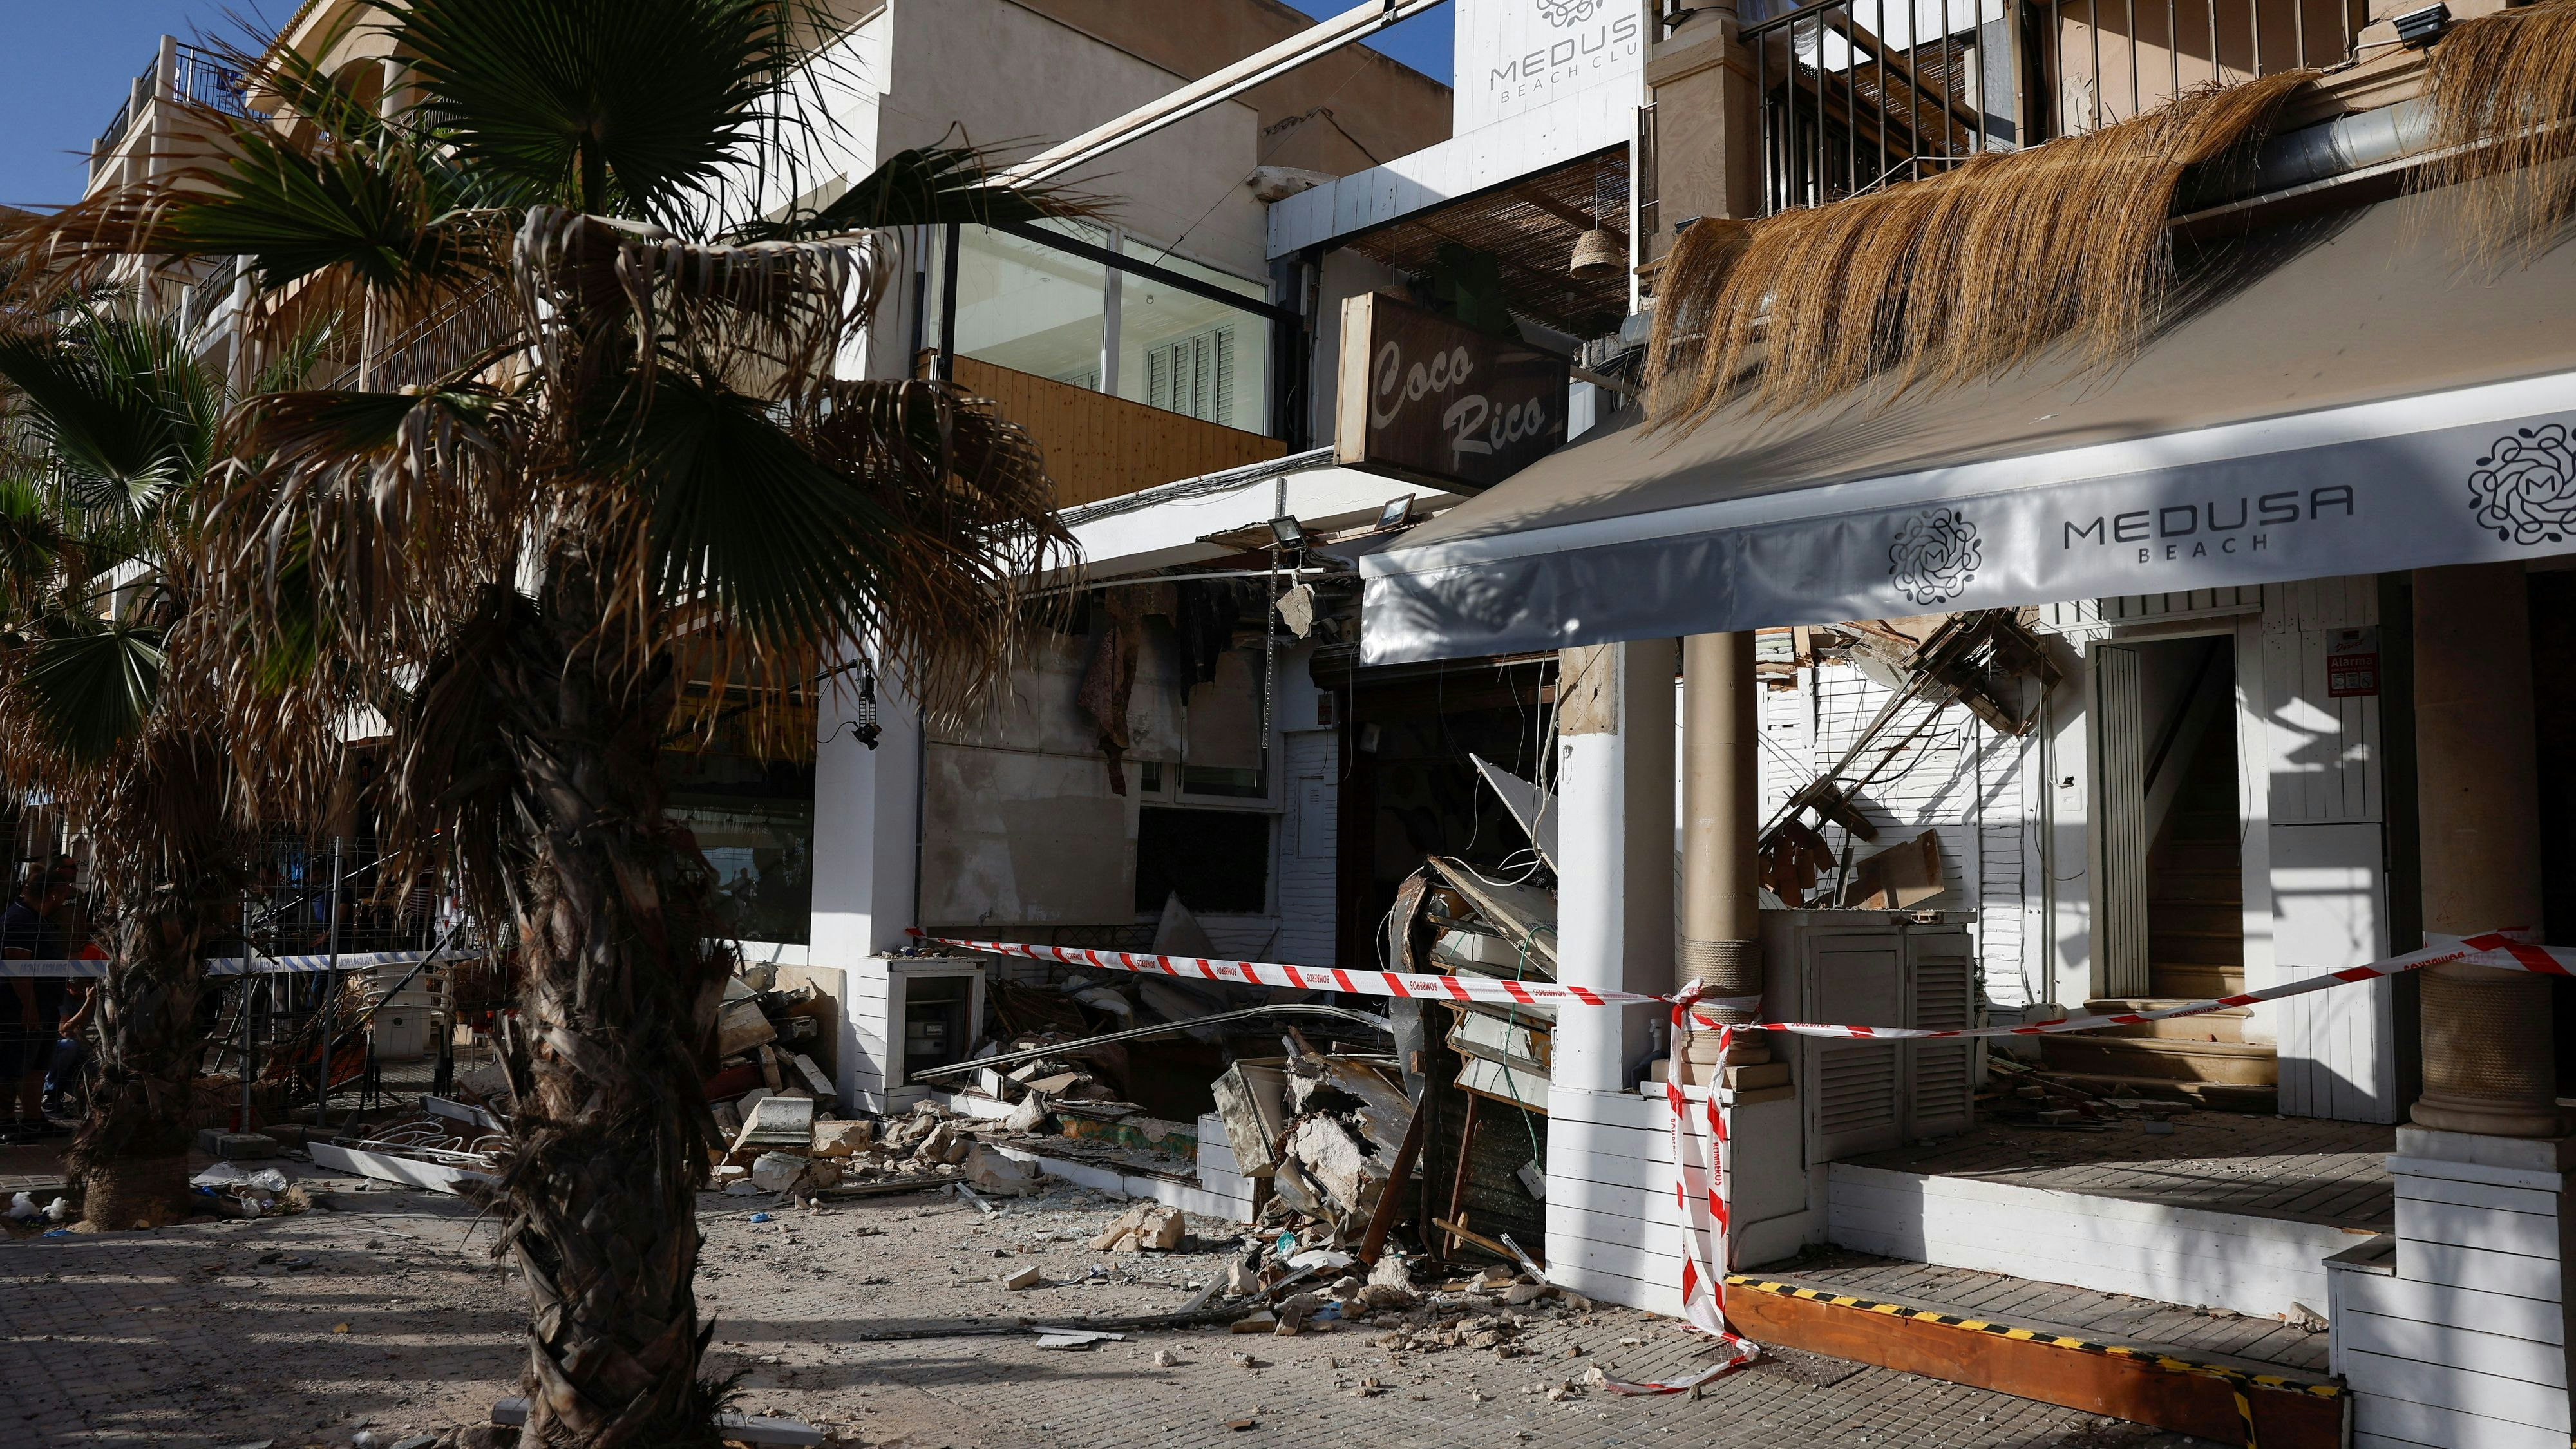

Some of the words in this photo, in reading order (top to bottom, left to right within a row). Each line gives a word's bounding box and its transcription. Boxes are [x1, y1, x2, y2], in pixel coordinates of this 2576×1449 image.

[1490, 13, 1637, 91] MEDUS
[1501, 64, 1578, 104] BEACH
[1592, 42, 1637, 69] CLU
[1372, 341, 1474, 430] Coco
[1443, 394, 1546, 472] Rico
[2065, 484, 2354, 549] MEDUSA
[2139, 533, 2269, 564] BEACH
[2331, 658, 2372, 667] Alarma
[1137, 959, 1155, 969] BOMBEROS
[1216, 966, 1237, 976] BOMBEROS
[1306, 973, 1330, 984] BOMBEROS
[1409, 980, 1438, 992] BOMBEROS
[1712, 1142, 1723, 1186] BOMBEROS
